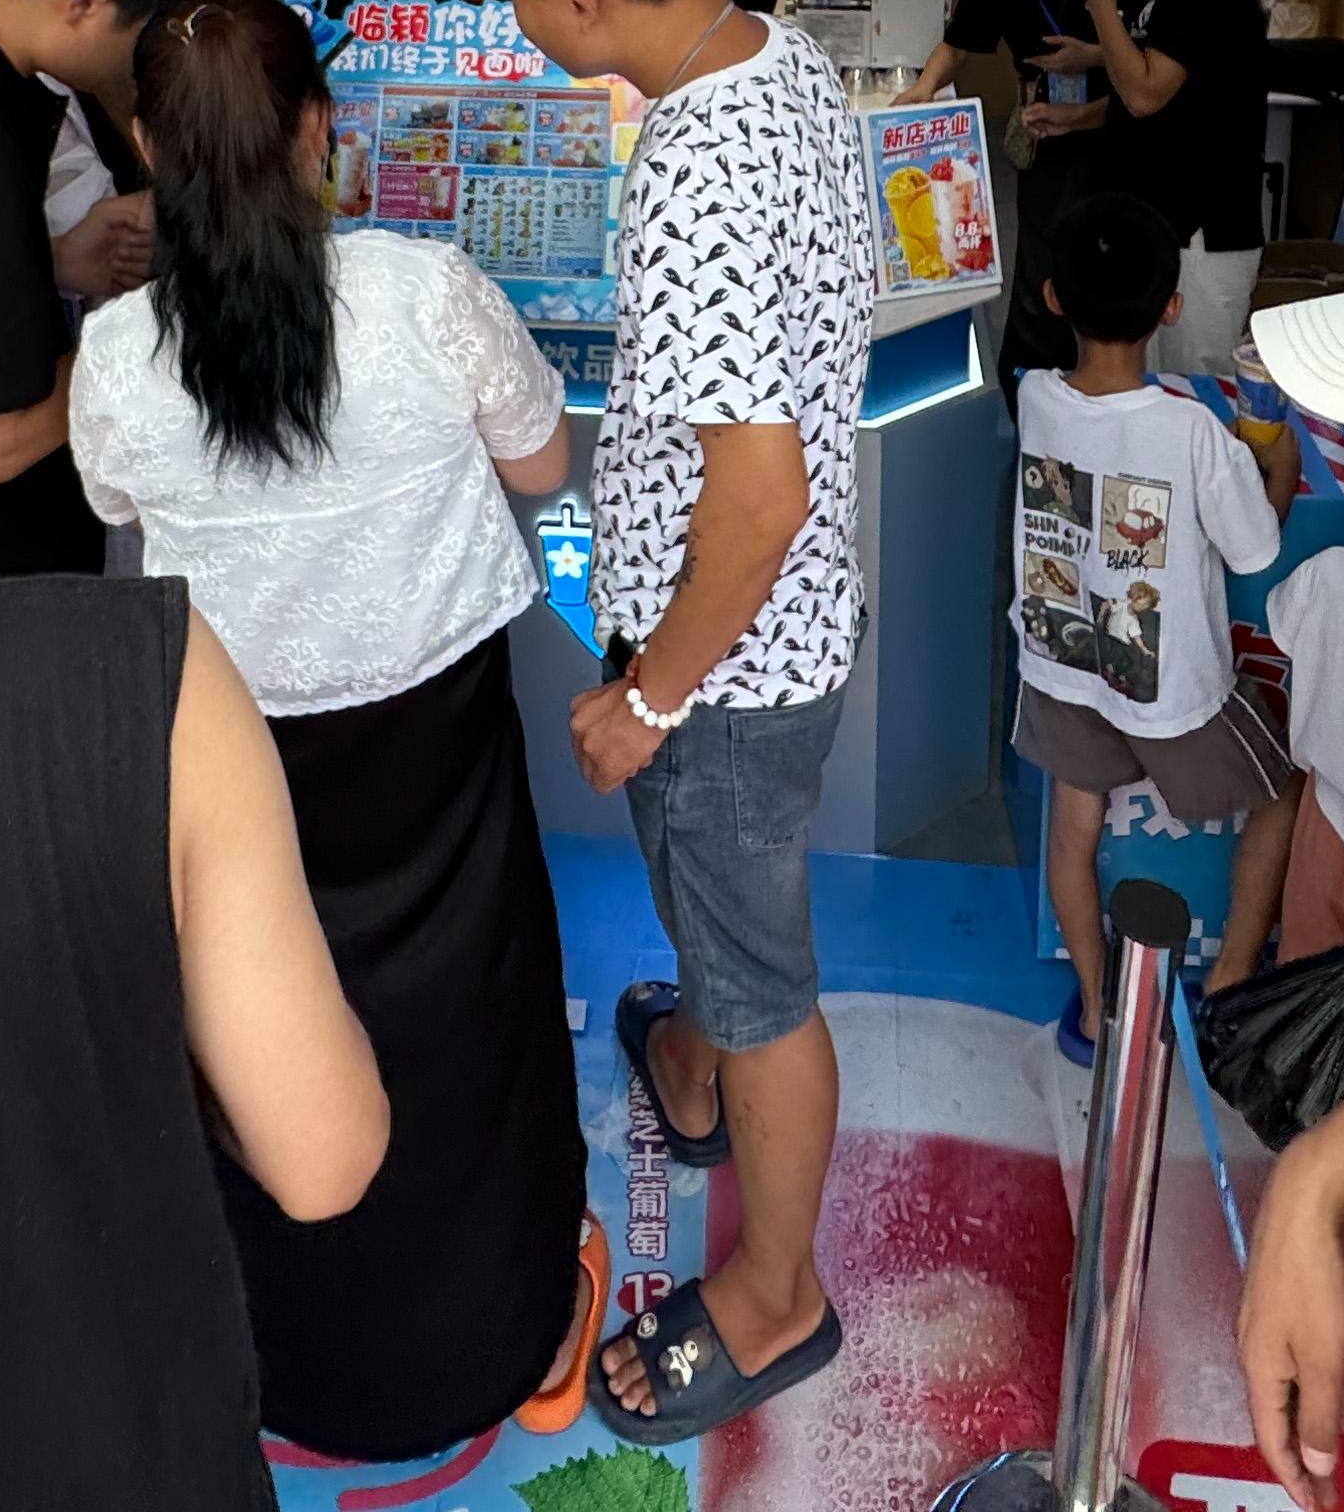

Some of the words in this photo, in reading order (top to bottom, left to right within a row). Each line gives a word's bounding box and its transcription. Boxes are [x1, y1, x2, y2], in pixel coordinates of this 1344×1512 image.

[331, 43, 546, 79] 我们终于见面啦
[882, 112, 972, 151] 新店开业
[541, 340, 617, 383] 饮品
[1106, 548, 1151, 573] BLACK
